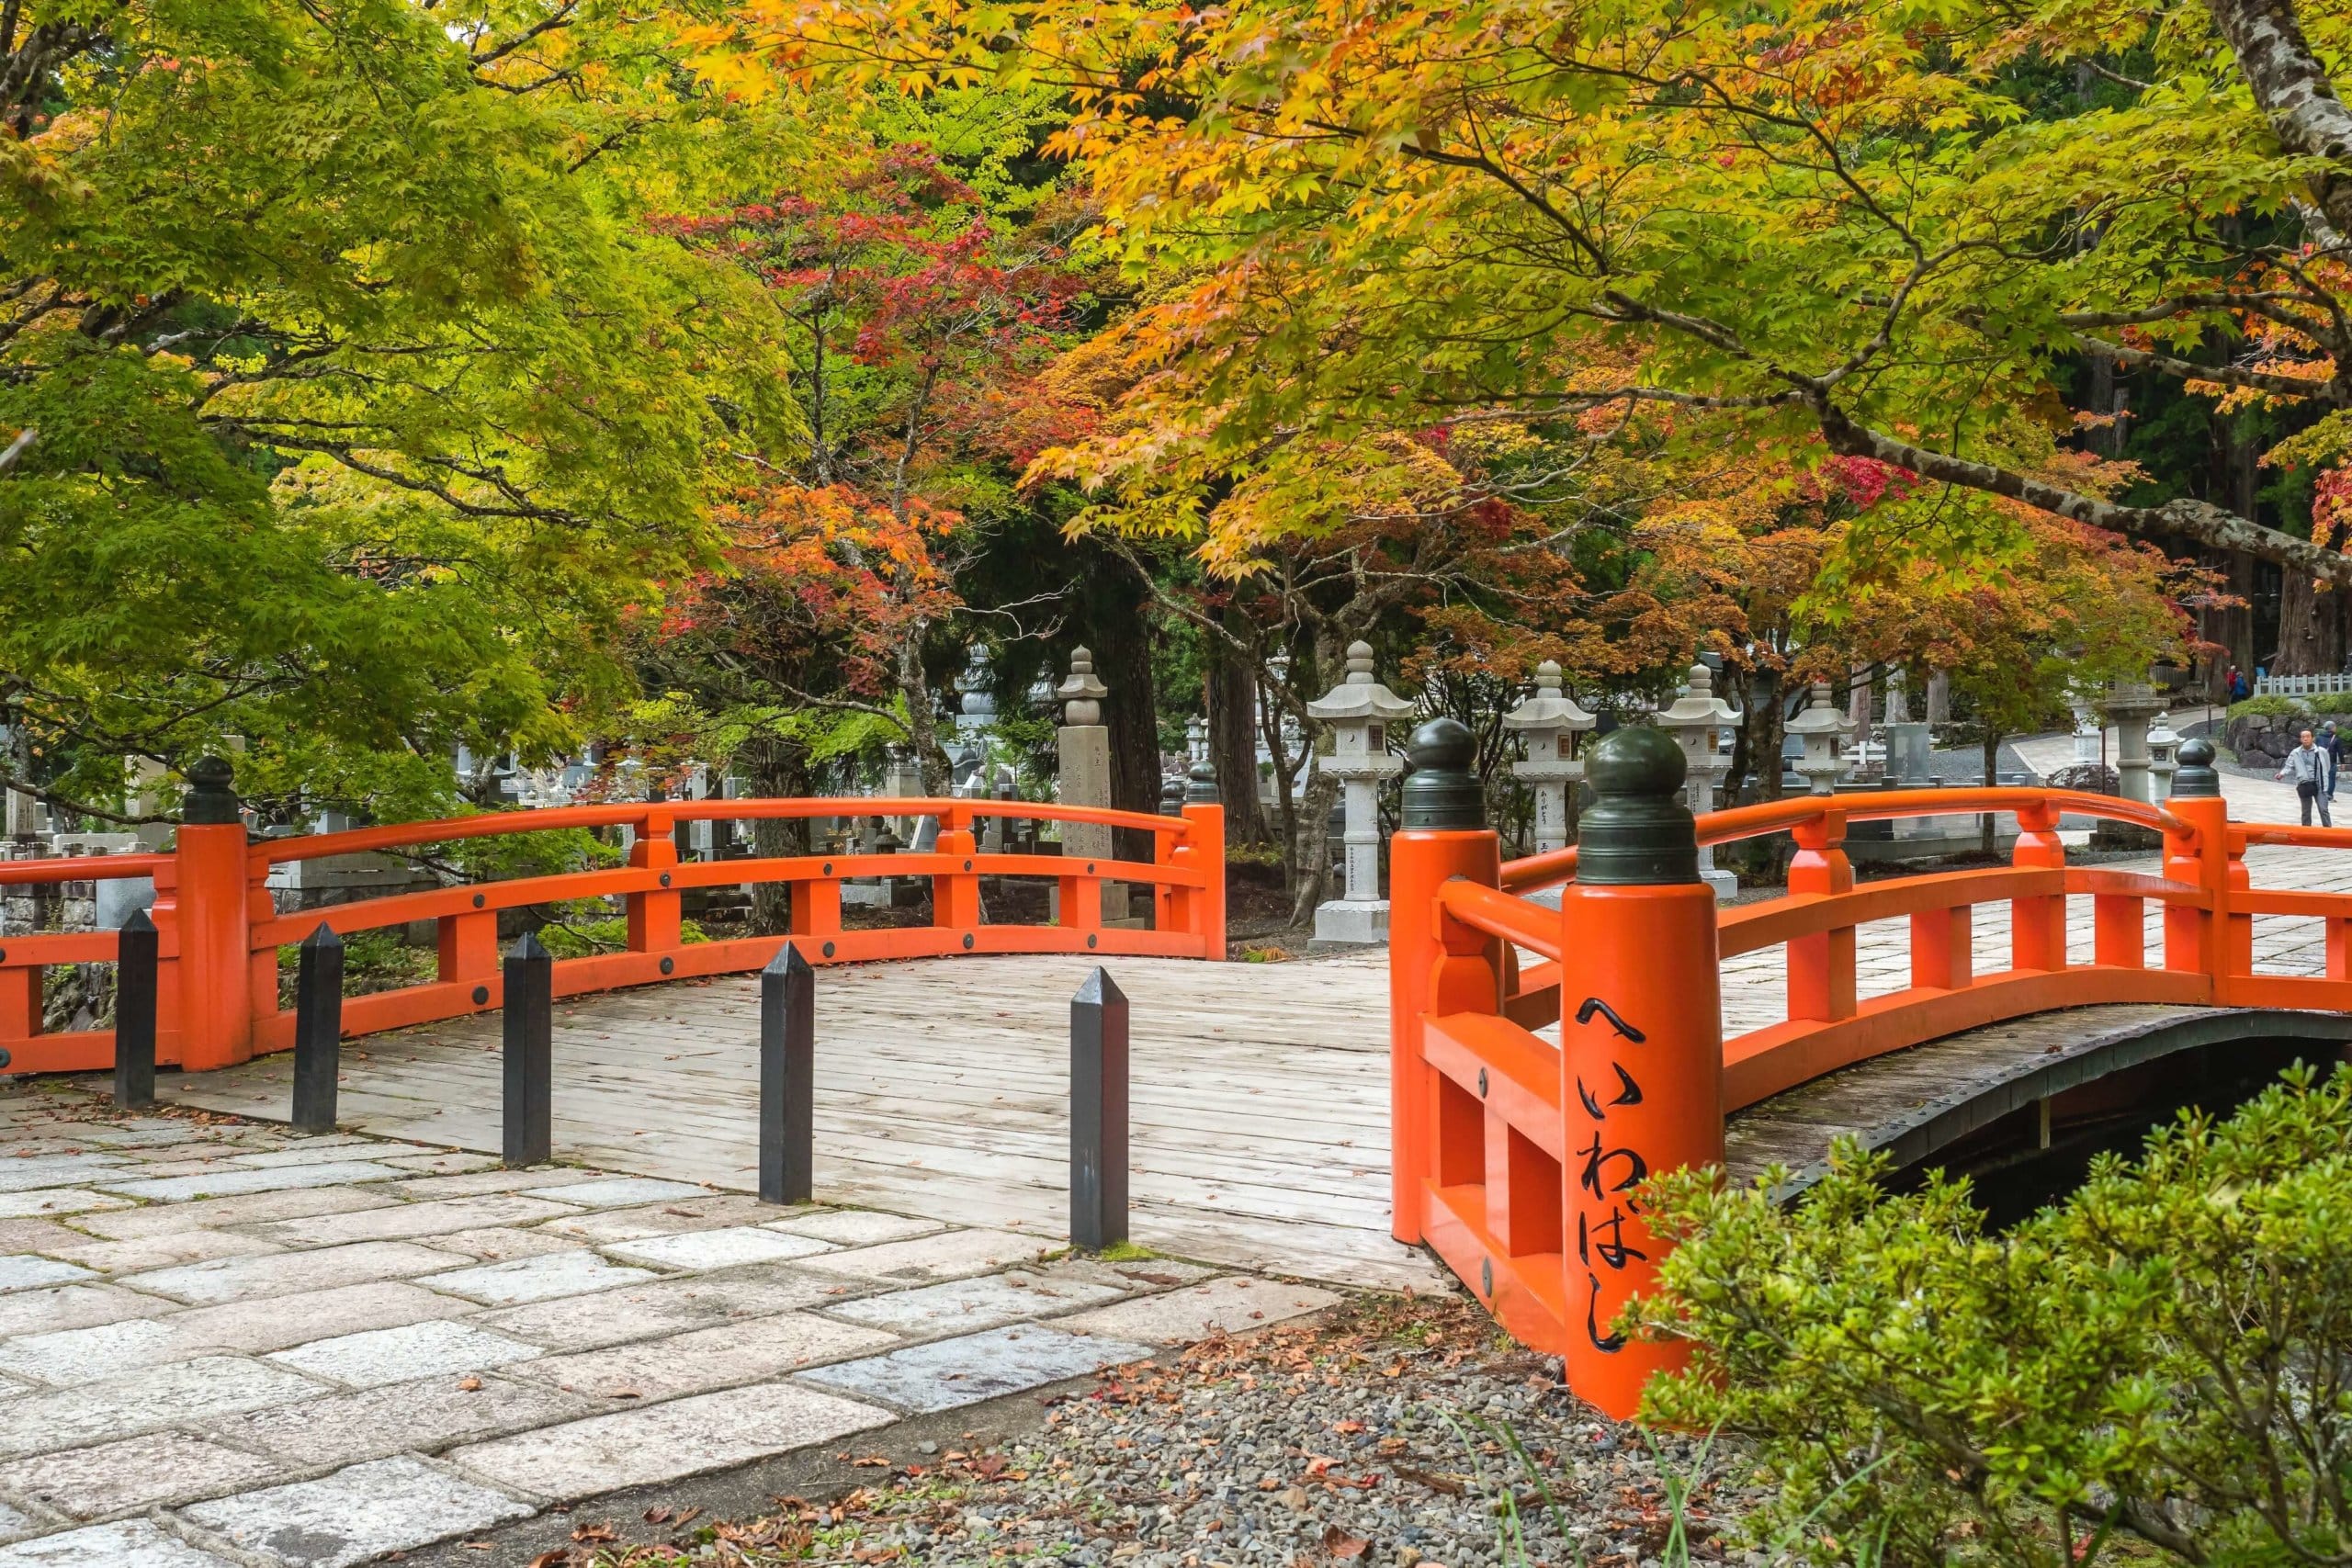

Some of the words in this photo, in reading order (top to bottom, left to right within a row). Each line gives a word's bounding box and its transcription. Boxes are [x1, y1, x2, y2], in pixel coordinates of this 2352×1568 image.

[1576, 997, 1647, 1353] へいわばし
